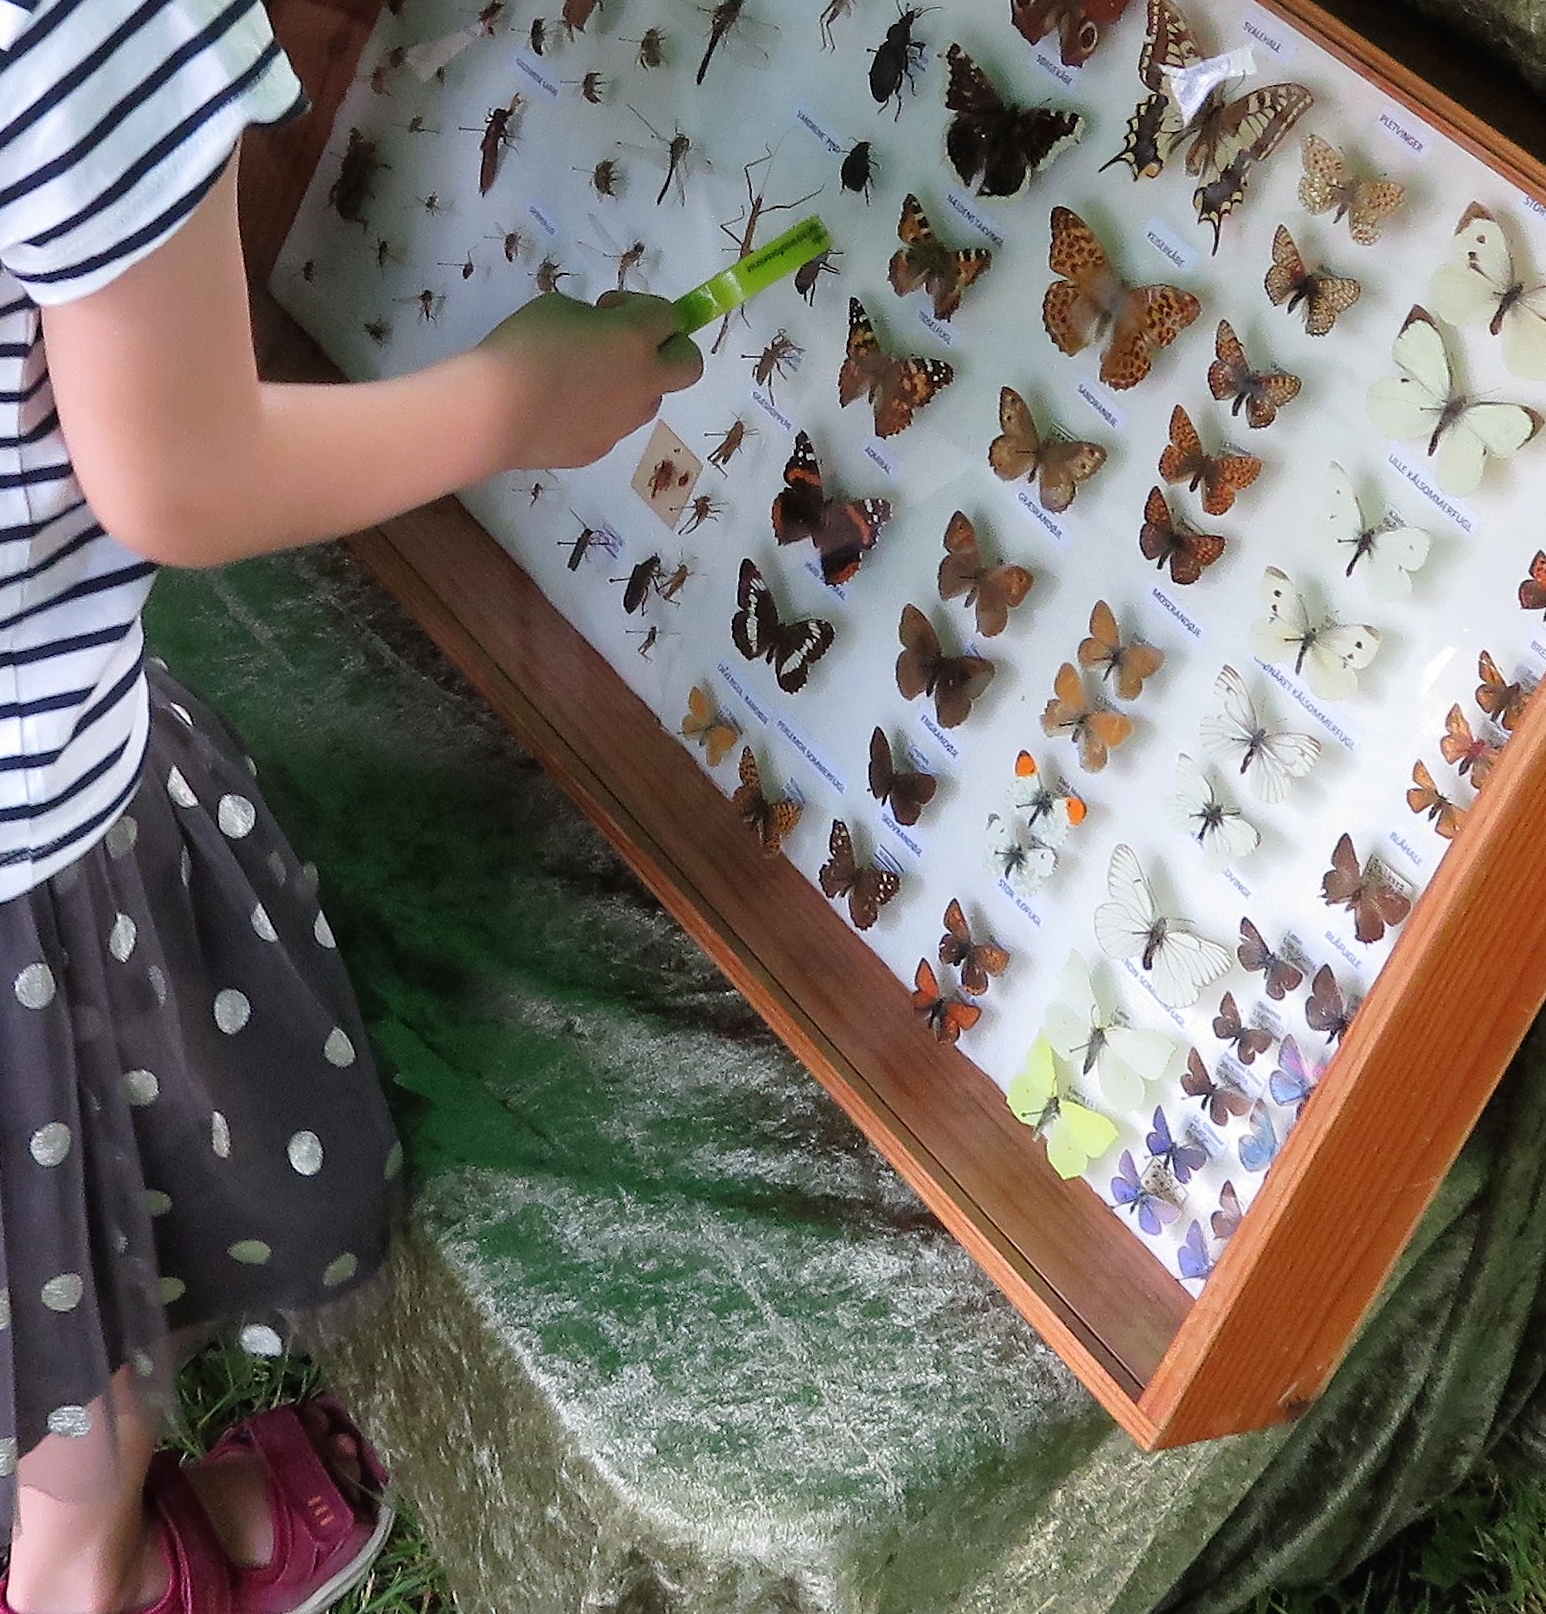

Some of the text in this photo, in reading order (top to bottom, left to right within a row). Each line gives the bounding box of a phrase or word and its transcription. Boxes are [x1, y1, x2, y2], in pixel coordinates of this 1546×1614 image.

[1378, 113, 1424, 153] PLETVINGER
[1387, 453, 1474, 533] LILLE KÅLSOMMERFUGL
[997, 877, 1016, 900] STOR
[1324, 928, 1363, 970] BLÅFUGLE
